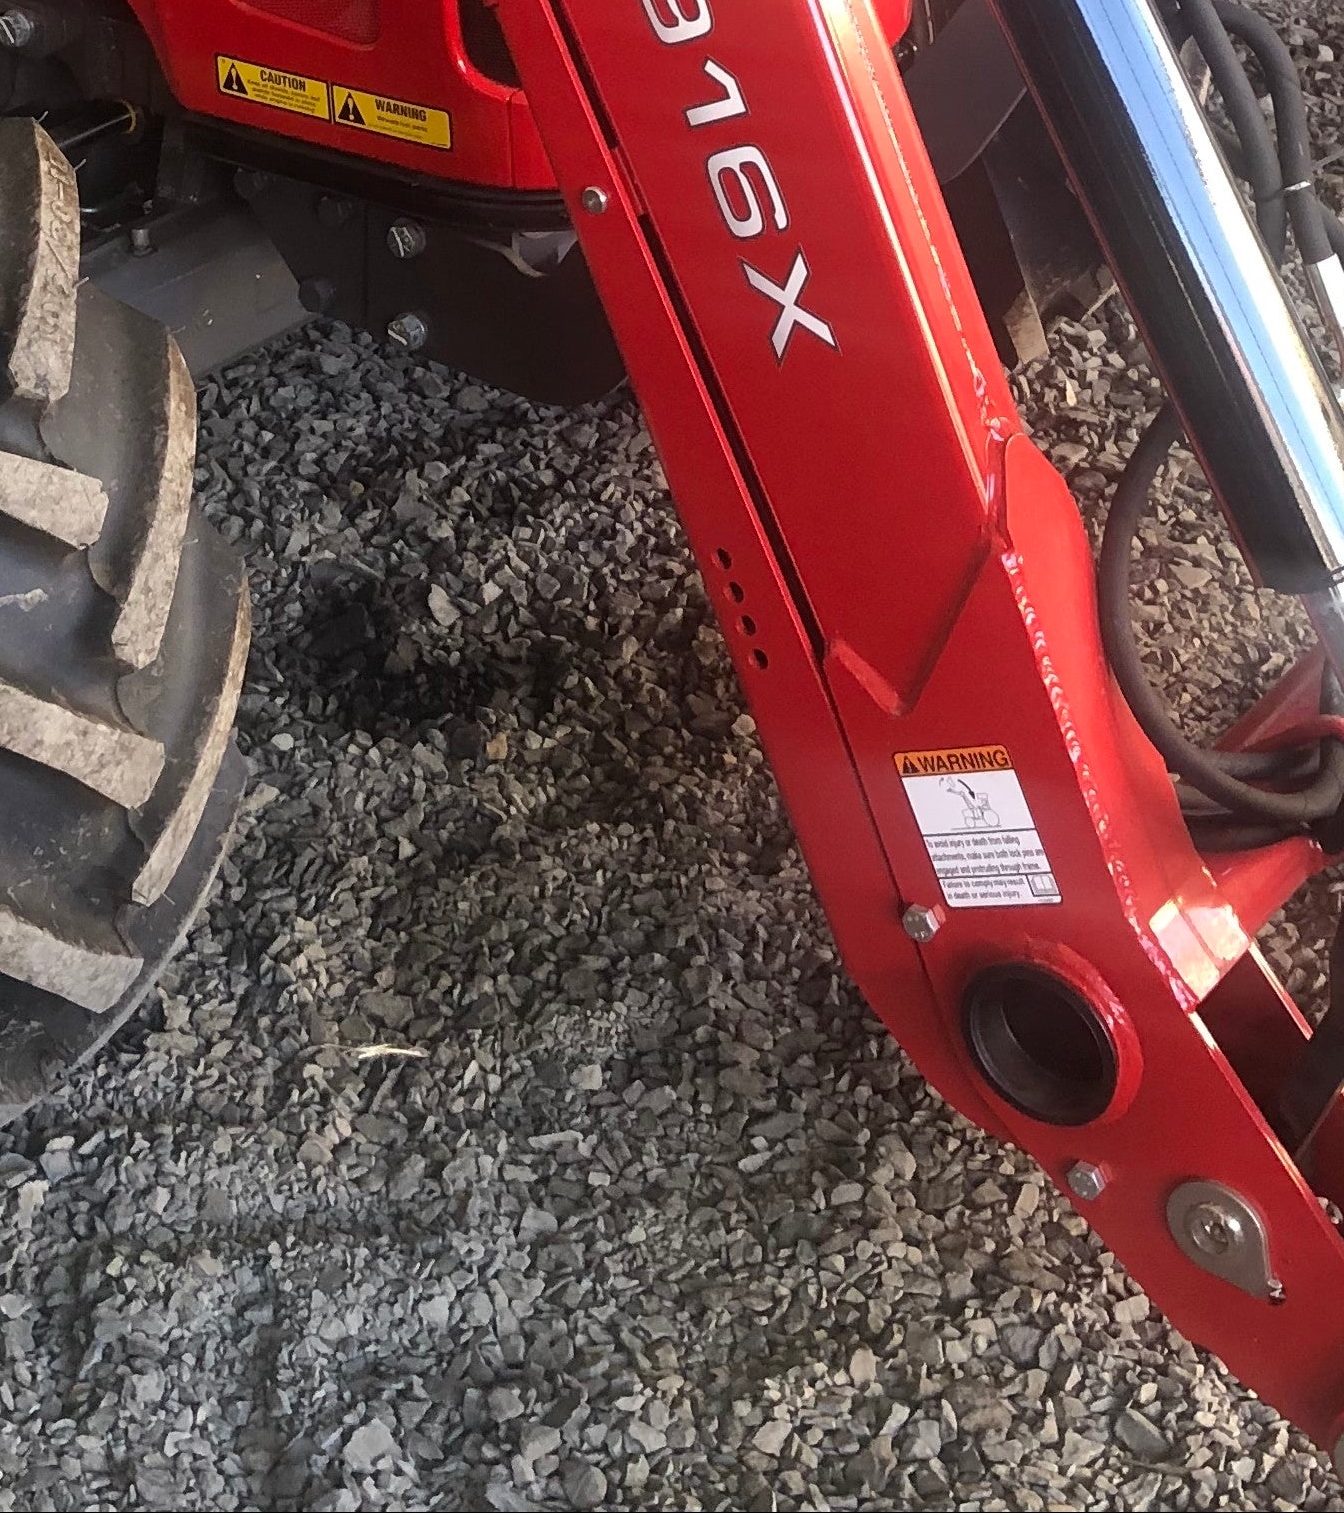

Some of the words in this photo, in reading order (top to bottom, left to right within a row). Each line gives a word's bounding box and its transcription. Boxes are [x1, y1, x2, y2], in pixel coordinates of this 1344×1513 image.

[259, 69, 307, 92] CAUTION
[374, 98, 427, 122] WARNING
[917, 750, 1008, 772] WARNING
